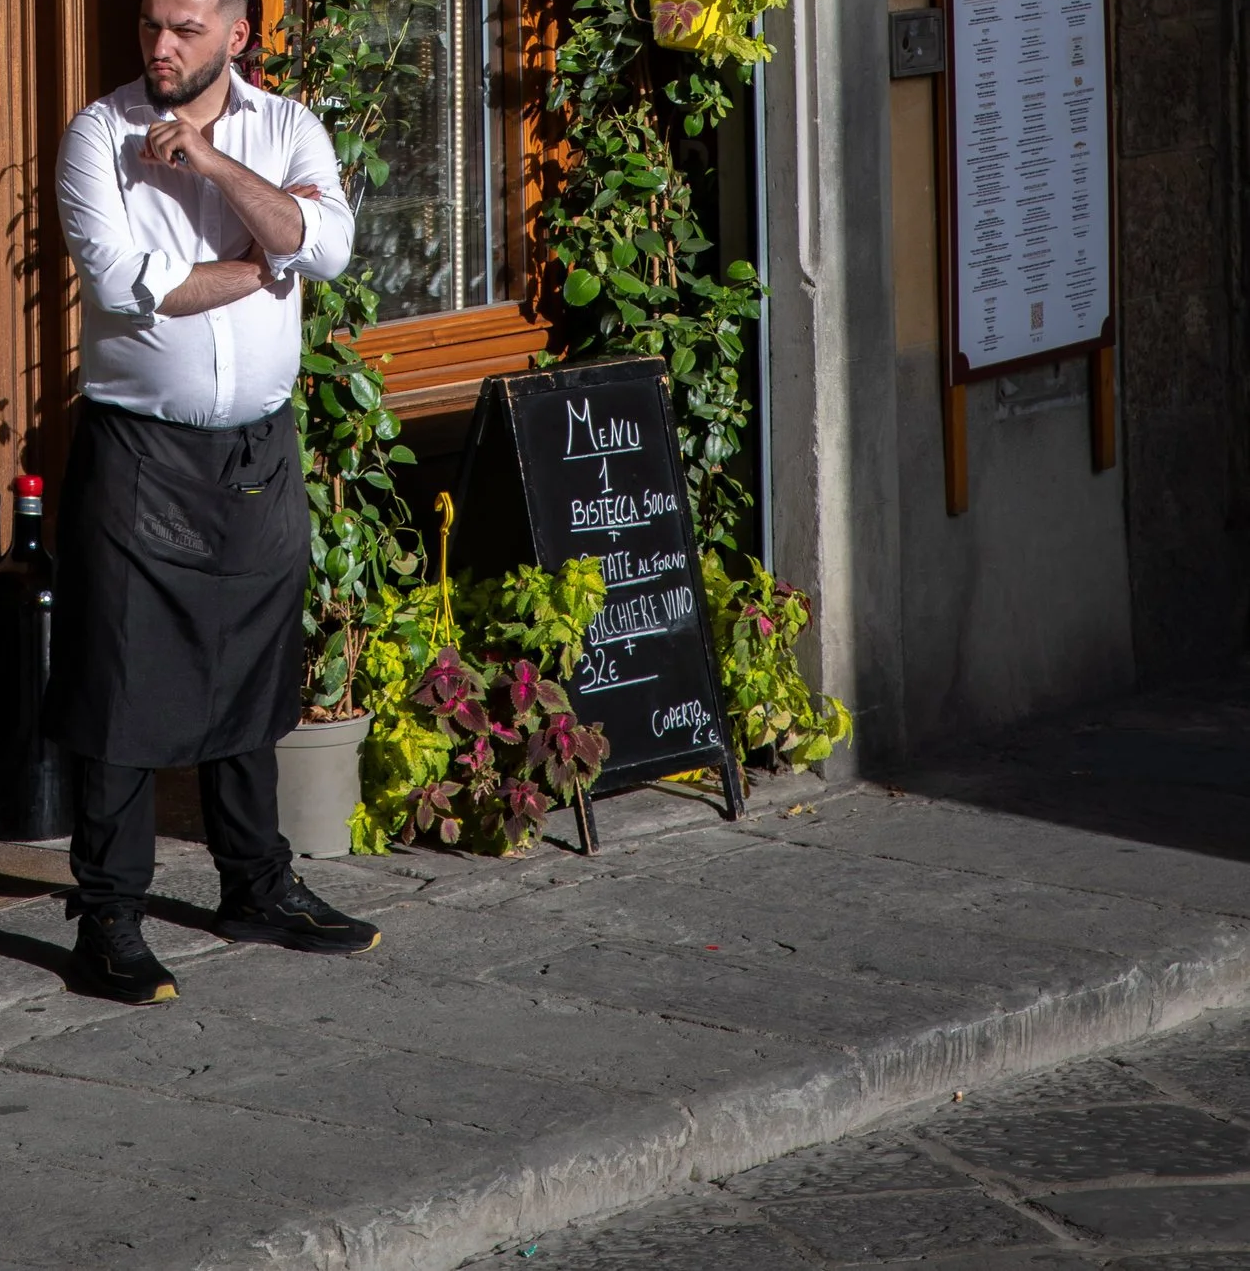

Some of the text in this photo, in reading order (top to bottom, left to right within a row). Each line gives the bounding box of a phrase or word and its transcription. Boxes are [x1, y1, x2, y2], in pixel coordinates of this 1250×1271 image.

[566, 398, 640, 455] MENU
[598, 457, 613, 494] 1
[571, 489, 678, 526] BISTECCA 500 GR
[579, 551, 686, 582] TATE AL FORNO
[588, 586, 694, 645] BICCHIERE VINO
[651, 699, 702, 738] COPERTO
